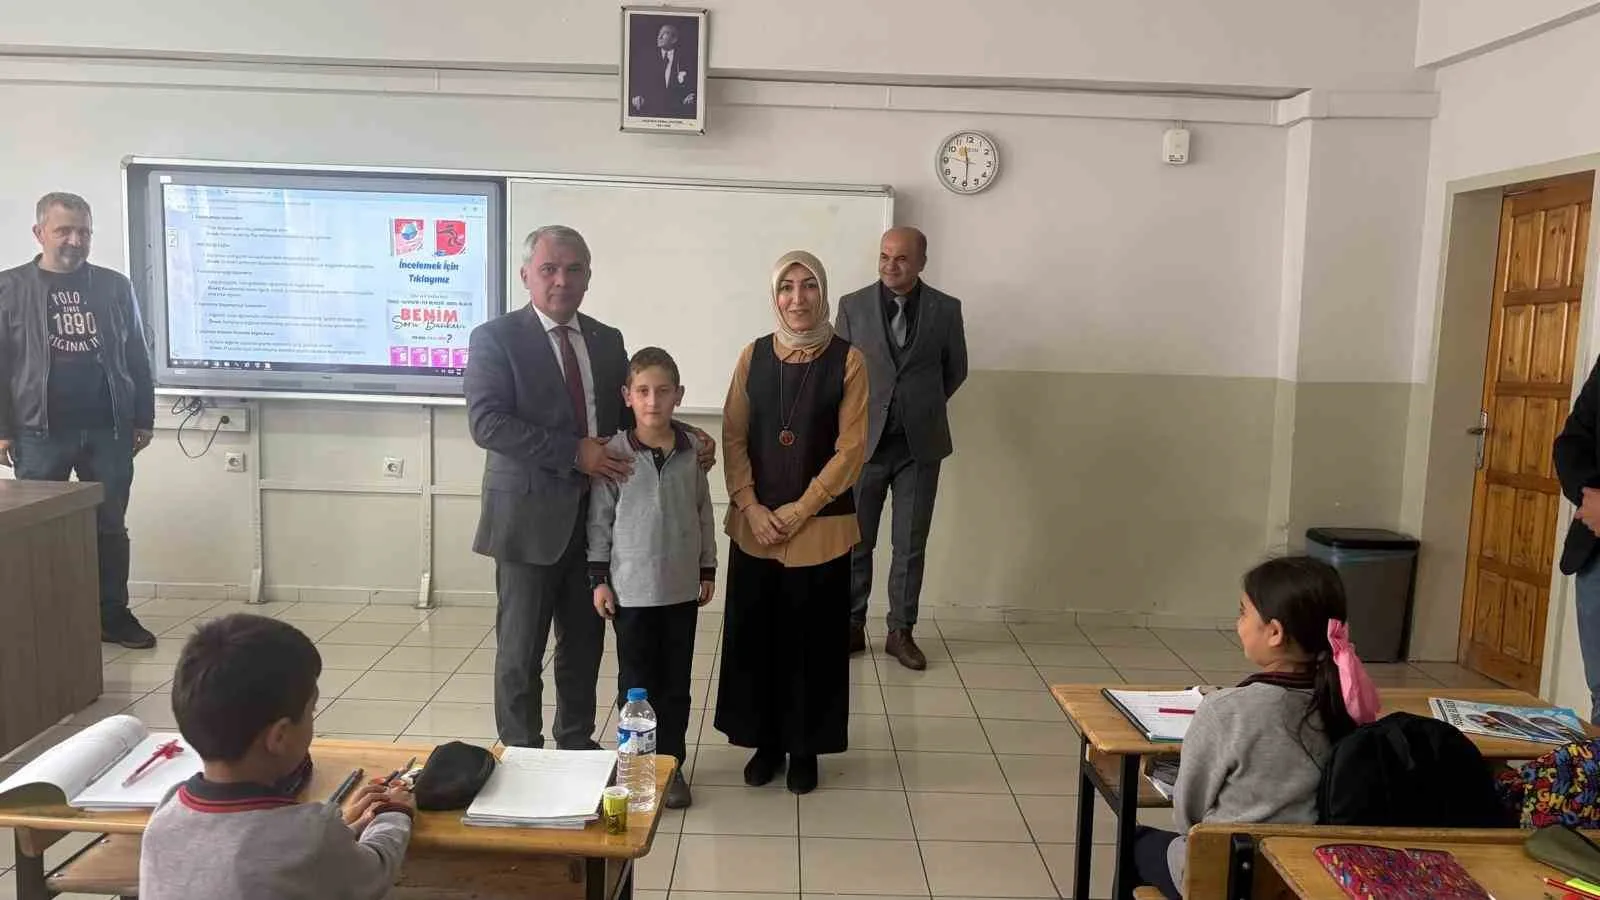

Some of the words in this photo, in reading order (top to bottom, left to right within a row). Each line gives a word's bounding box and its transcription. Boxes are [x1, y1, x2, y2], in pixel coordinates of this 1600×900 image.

[399, 258, 442, 270] İncelemek
[443, 260, 459, 272] İçin
[408, 274, 450, 285] Tıklayınız
[52, 291, 80, 305] POLO
[400, 305, 458, 323] BENİM
[53, 311, 97, 335] 1890
